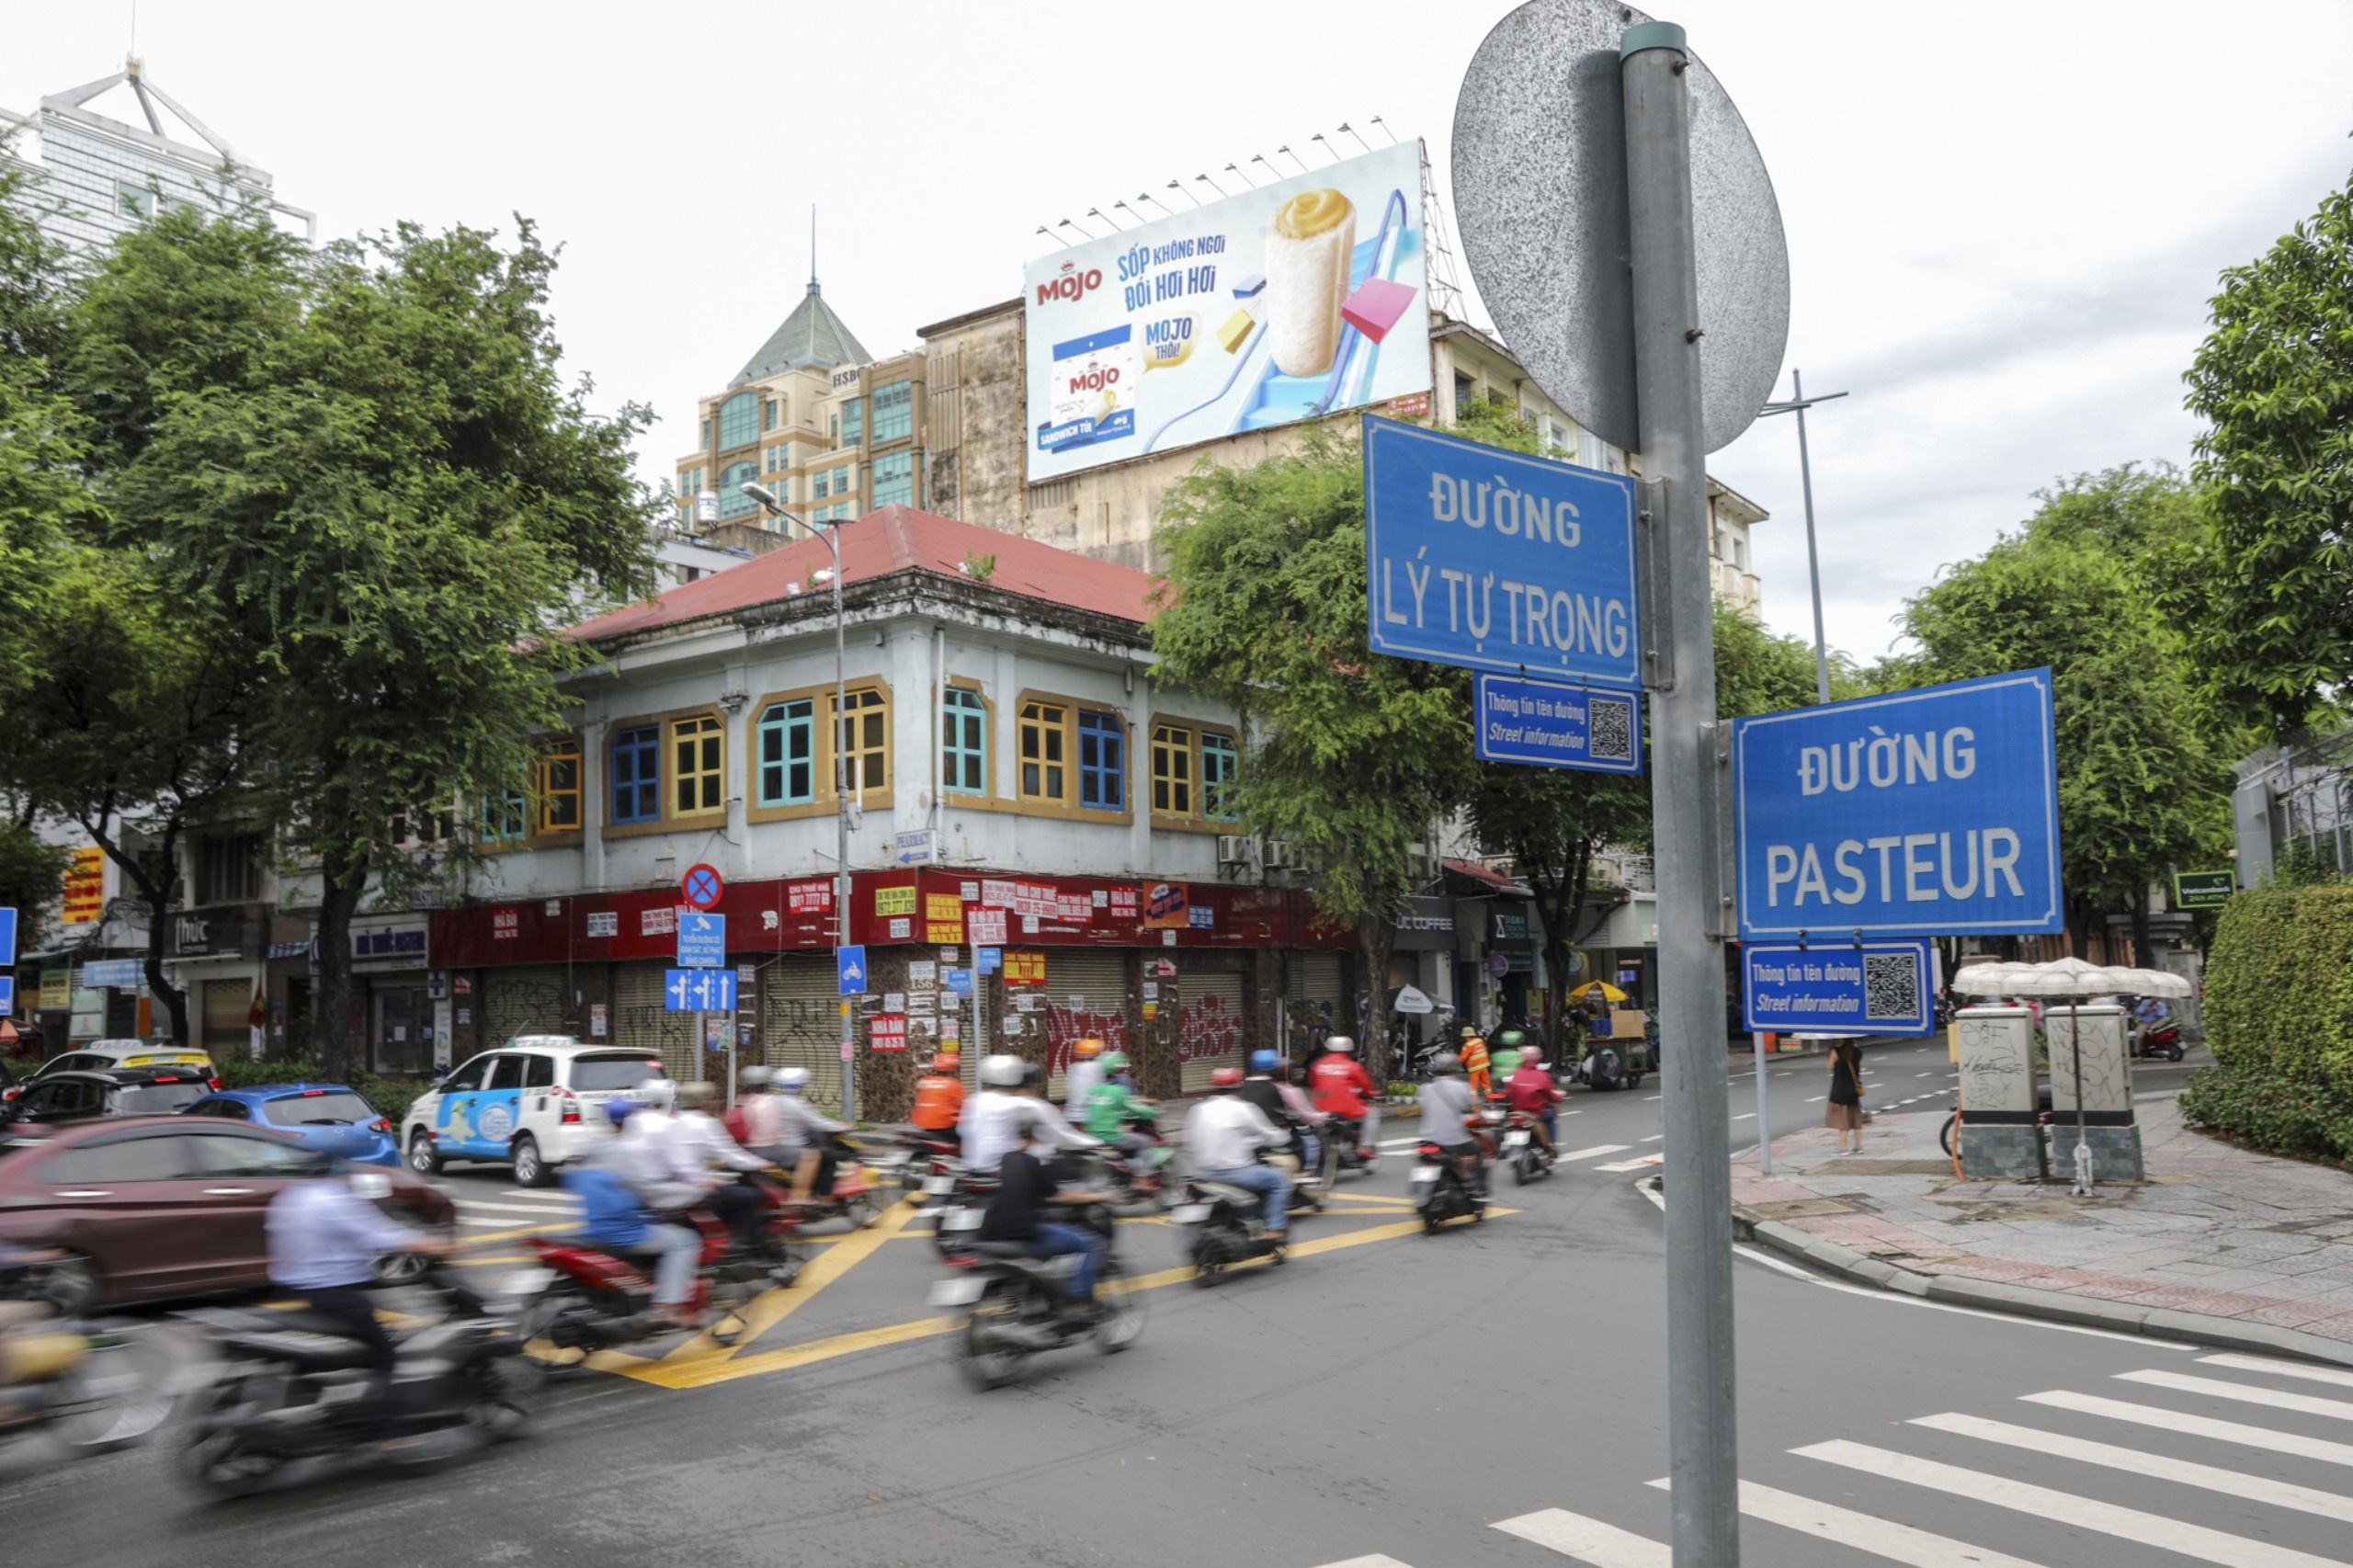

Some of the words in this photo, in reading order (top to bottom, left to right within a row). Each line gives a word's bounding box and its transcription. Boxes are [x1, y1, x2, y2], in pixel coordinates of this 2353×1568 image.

[1118, 243, 1150, 281] SỐP
[1154, 240, 1194, 266] KHÔNG
[1037, 269, 1102, 305] MOJO
[1146, 317, 1192, 345] MOJO
[1070, 368, 1120, 394] MOJO
[1040, 425, 1078, 445] SANDWICH
[1428, 472, 1581, 548] ĐƯỜNG
[1383, 545, 1430, 629] LÝ
[1440, 568, 1494, 653] TỰ
[1502, 580, 1627, 665] TRỌNG
[1486, 691, 1519, 718] Thông
[1520, 696, 1535, 715] tin
[1536, 696, 1552, 717] tên
[1554, 699, 1586, 724] đường
[1488, 722, 1523, 744] Street
[1524, 726, 1586, 749] information
[1797, 726, 1976, 796] ĐƯỜNG
[897, 833, 930, 848] PHARMACY
[1767, 827, 2025, 907] PASTEUR
[789, 885, 801, 894] CHO
[802, 883, 816, 892] THUÊ
[817, 881, 830, 892] NHÀ
[1030, 885, 1041, 899] CHO
[1413, 917, 1453, 930] COFFEE
[910, 979, 934, 990] 156
[1752, 963, 1785, 986] Thông
[1786, 962, 1802, 982] tin
[1803, 962, 1824, 982] tên
[1824, 961, 1861, 986] đường
[1756, 994, 1790, 1012] Street
[1792, 994, 1860, 1013] information
[871, 1016, 887, 1034] NHÀ
[889, 1016, 904, 1034] BÁN
